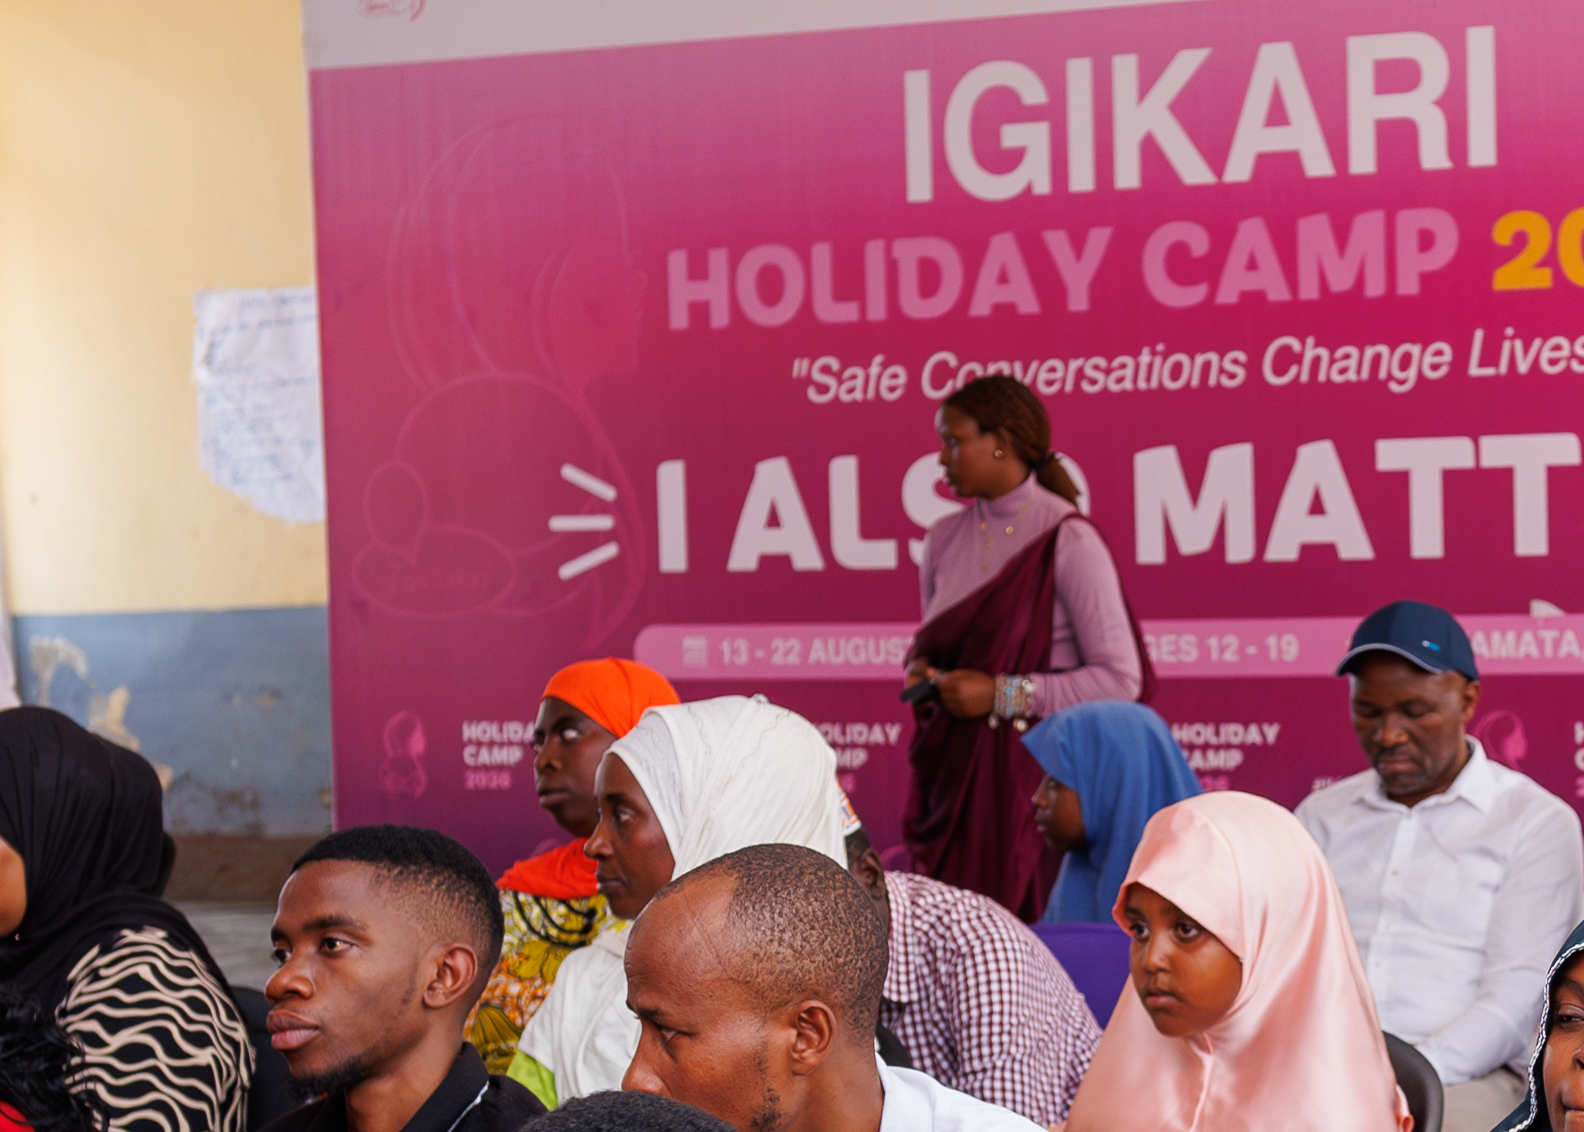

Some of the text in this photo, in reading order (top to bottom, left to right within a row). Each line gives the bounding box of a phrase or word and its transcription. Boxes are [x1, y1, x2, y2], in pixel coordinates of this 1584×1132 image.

[902, 24, 1499, 204] IGIKARI
[666, 226, 1113, 331] HOLIDAY
[1140, 207, 1461, 312] CAMP
[792, 354, 908, 404] "Safe
[1261, 335, 1453, 394] Change
[655, 458, 689, 574] I
[719, 637, 749, 667] 13
[770, 637, 801, 666] 22
[1143, 633, 1199, 663] GES
[1205, 633, 1240, 663] 12
[1265, 632, 1299, 663] 19
[462, 720, 536, 744] HOLIDA
[814, 721, 904, 747] OLIDAY
[1171, 721, 1281, 746] HOLIDAY
[463, 744, 524, 768] CAMP
[1186, 747, 1244, 771] AMP
